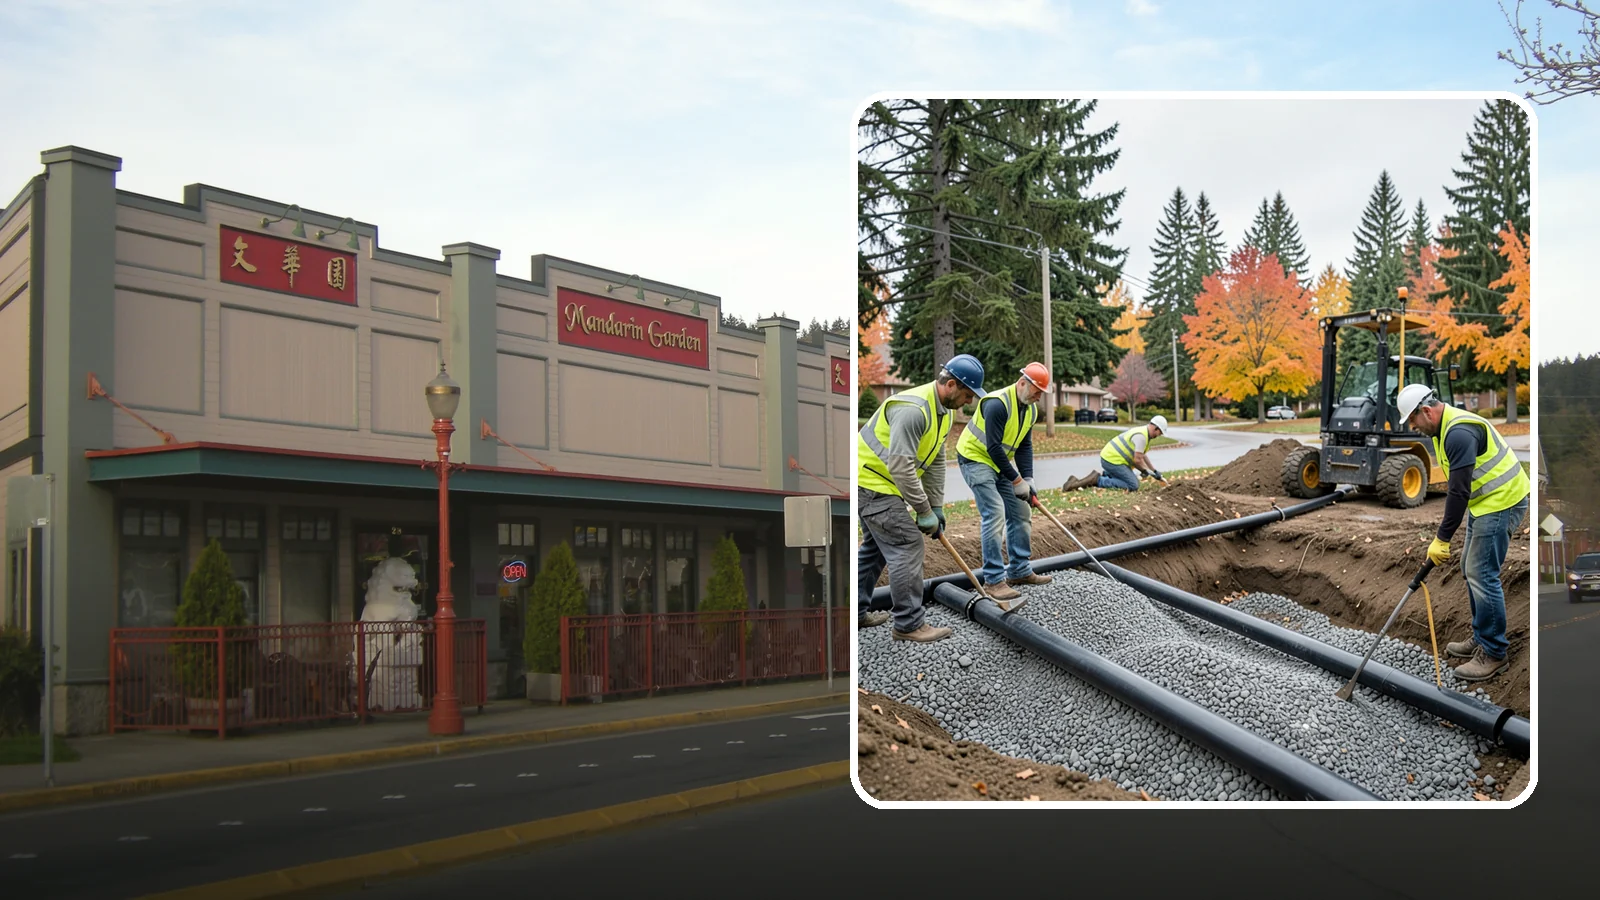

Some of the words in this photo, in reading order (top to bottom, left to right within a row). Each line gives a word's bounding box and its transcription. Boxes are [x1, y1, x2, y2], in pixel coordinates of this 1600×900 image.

[230, 235, 346, 291] 文華園
[564, 302, 644, 341] Mandarin
[648, 320, 701, 352] Garden
[503, 565, 527, 578] OPEN
